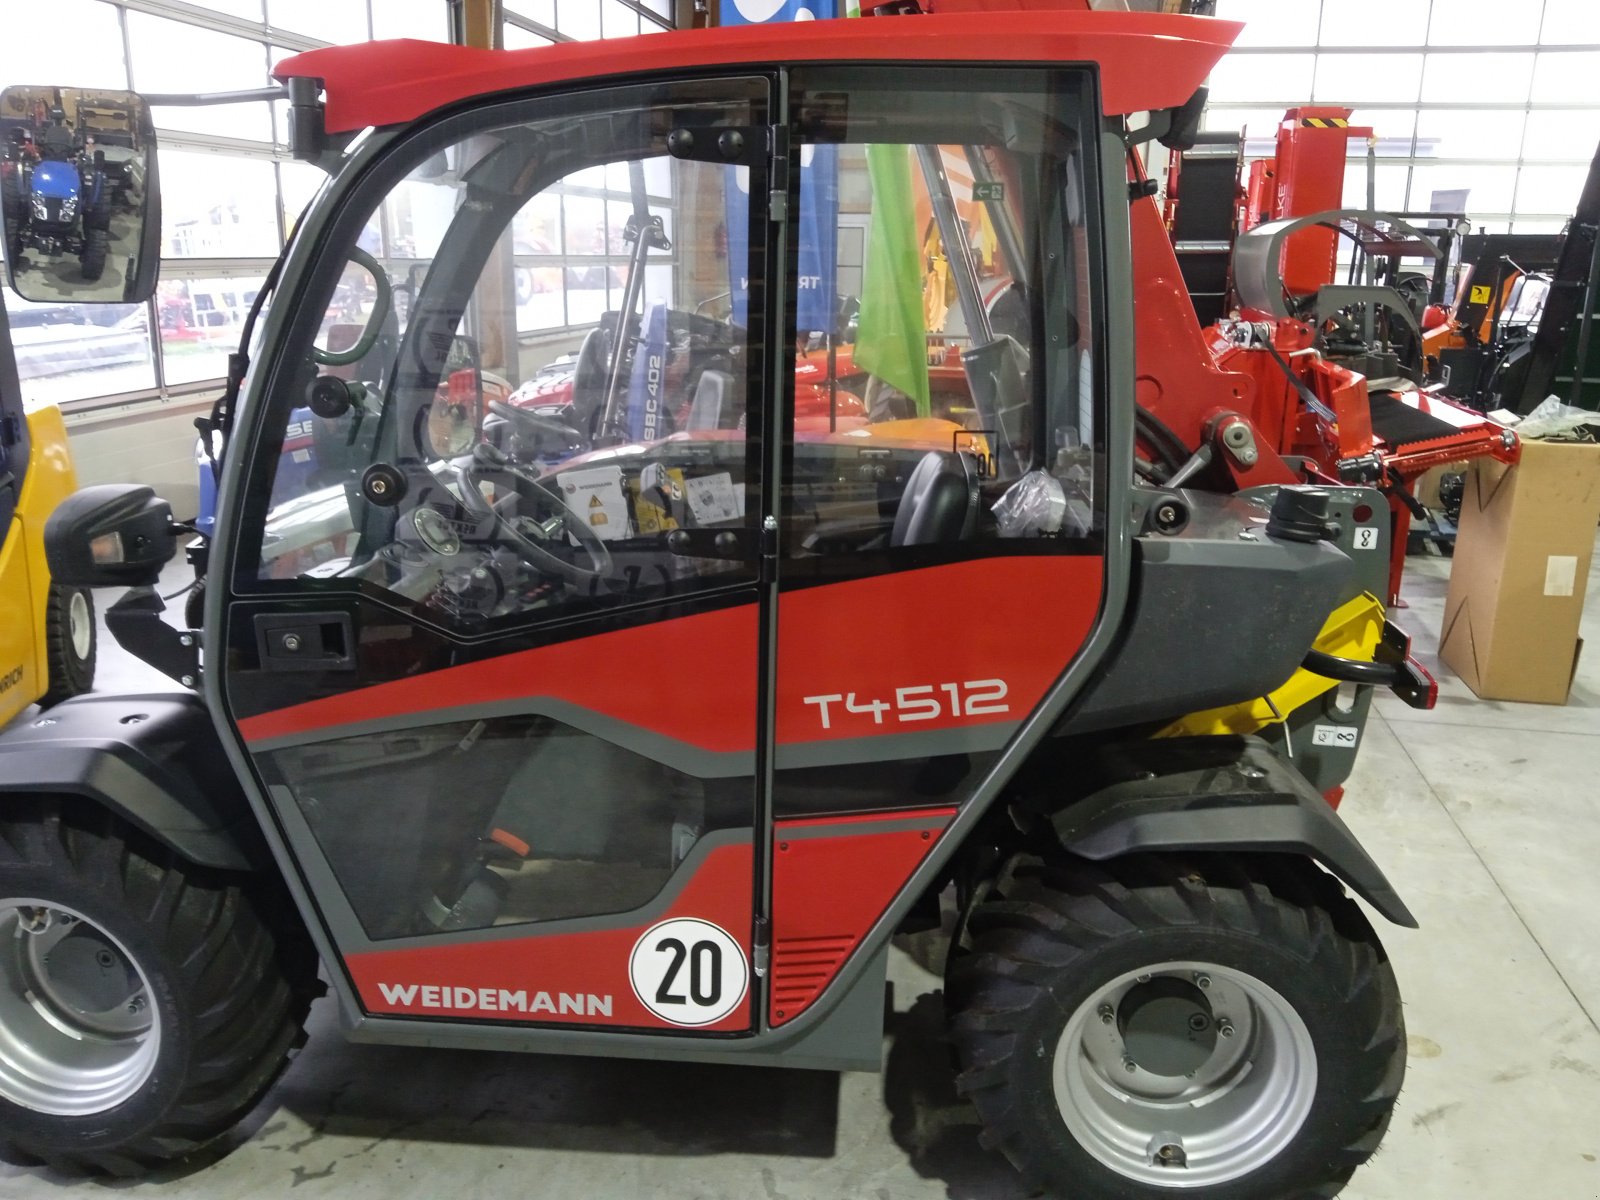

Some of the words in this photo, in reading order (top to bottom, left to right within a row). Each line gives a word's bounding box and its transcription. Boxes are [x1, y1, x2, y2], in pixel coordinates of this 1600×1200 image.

[648, 355, 661, 396] 402
[644, 399, 657, 441] SBC
[803, 678, 1010, 729] T4512
[655, 937, 722, 1007] 20
[377, 982, 613, 1018] WEIDEMANN
